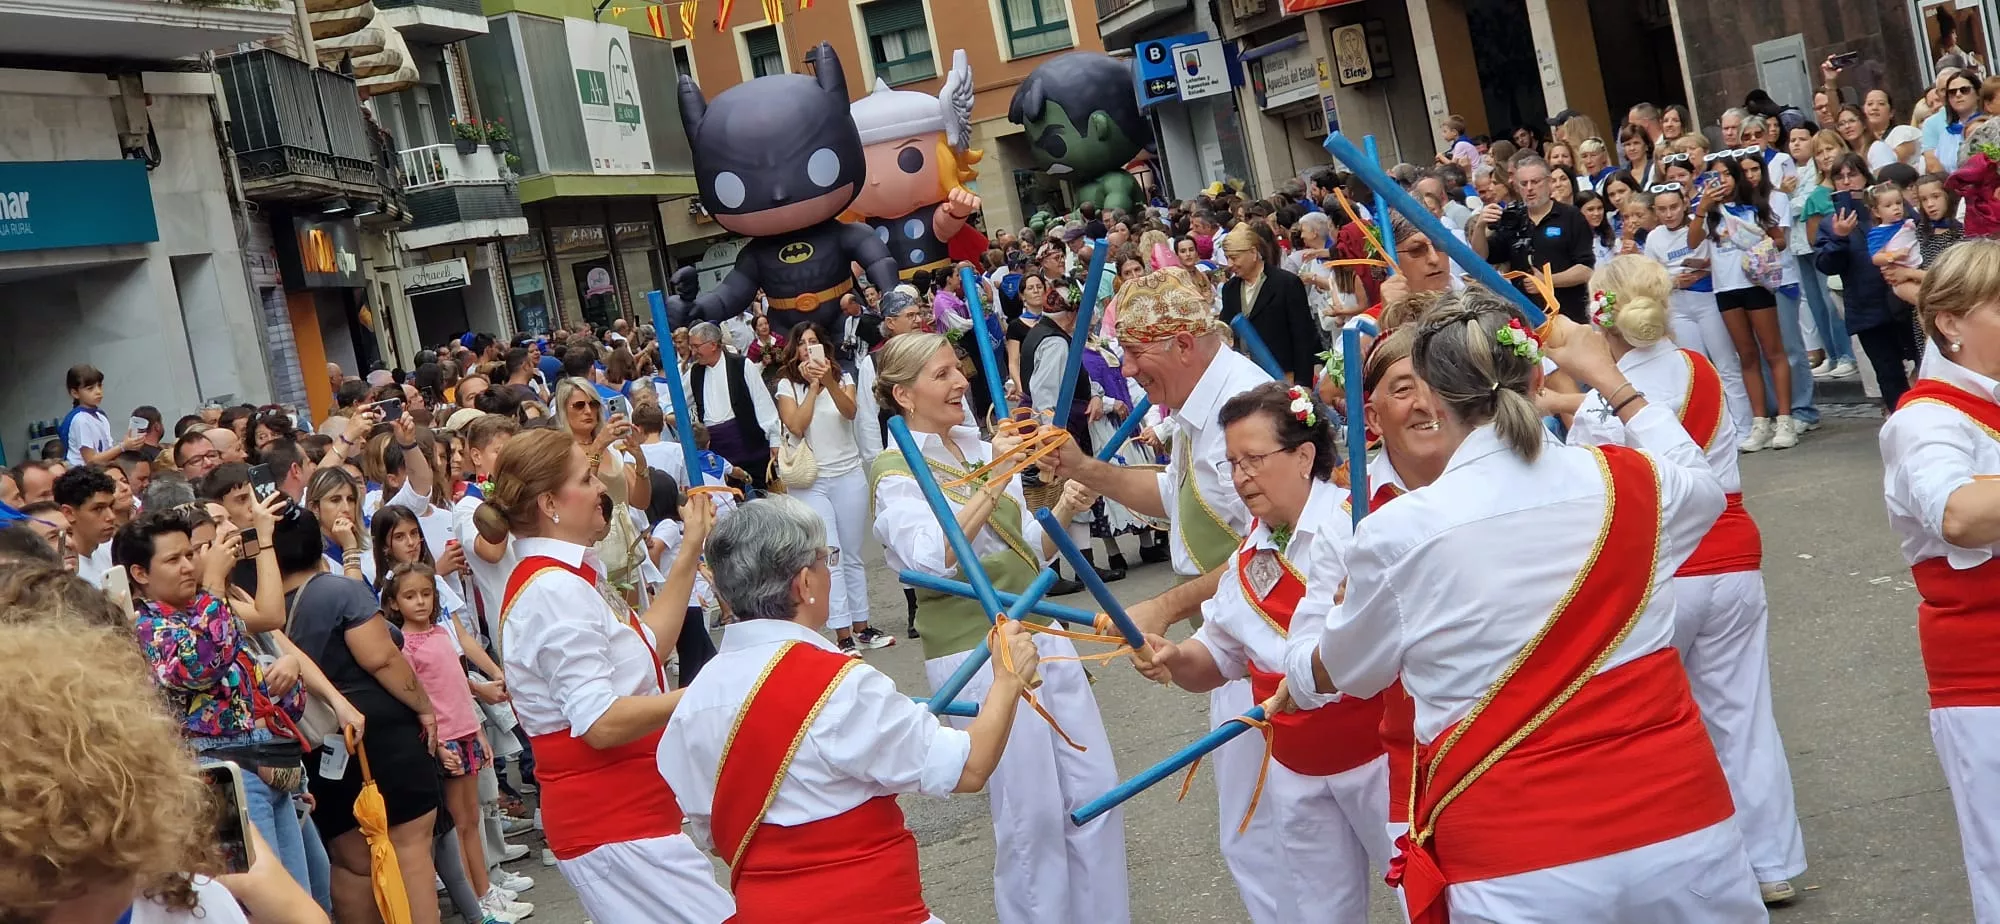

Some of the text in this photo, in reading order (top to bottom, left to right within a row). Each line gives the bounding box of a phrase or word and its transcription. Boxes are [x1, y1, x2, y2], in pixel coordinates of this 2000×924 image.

[1149, 47, 1161, 60] B
[1344, 67, 1367, 79] Elena
[1308, 110, 1323, 132] LO
[10, 222, 34, 235] RURAL
